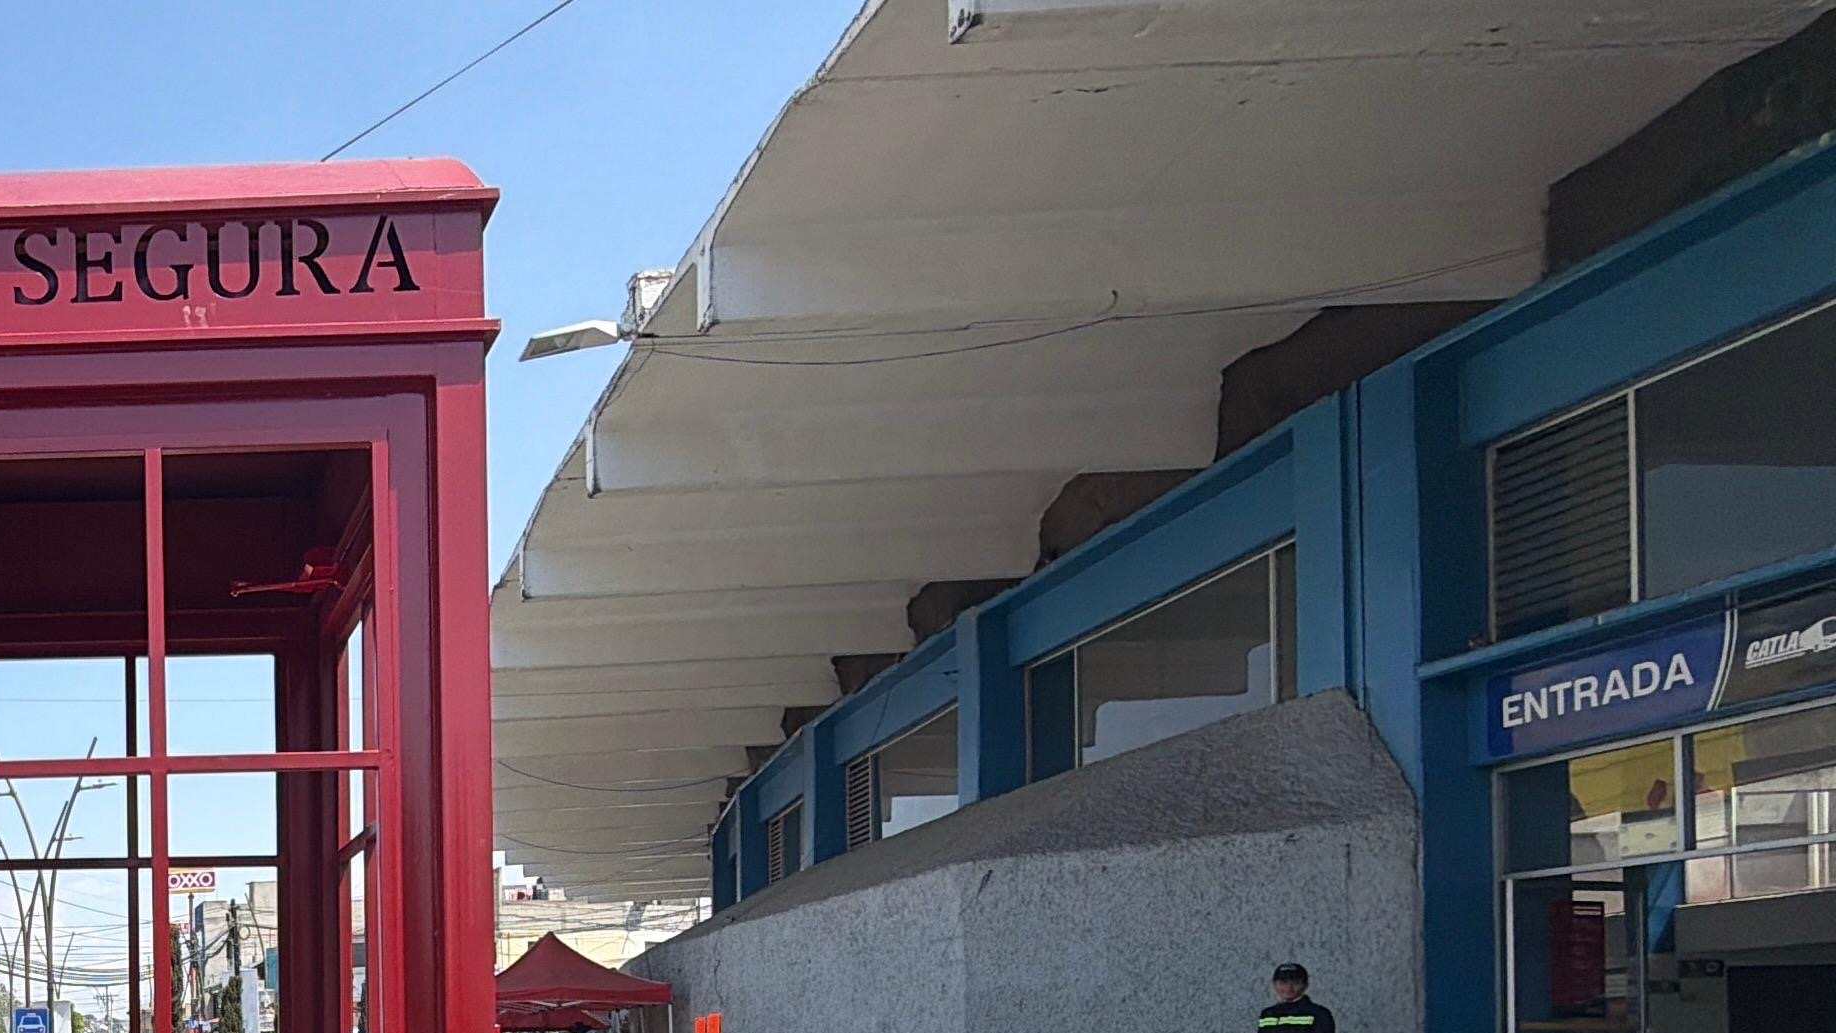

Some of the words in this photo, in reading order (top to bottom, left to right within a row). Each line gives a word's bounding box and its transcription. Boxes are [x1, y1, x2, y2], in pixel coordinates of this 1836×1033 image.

[13, 215, 421, 306] SEGURA
[1502, 652, 1695, 728] ENTRADA
[168, 871, 213, 889] OXXO
